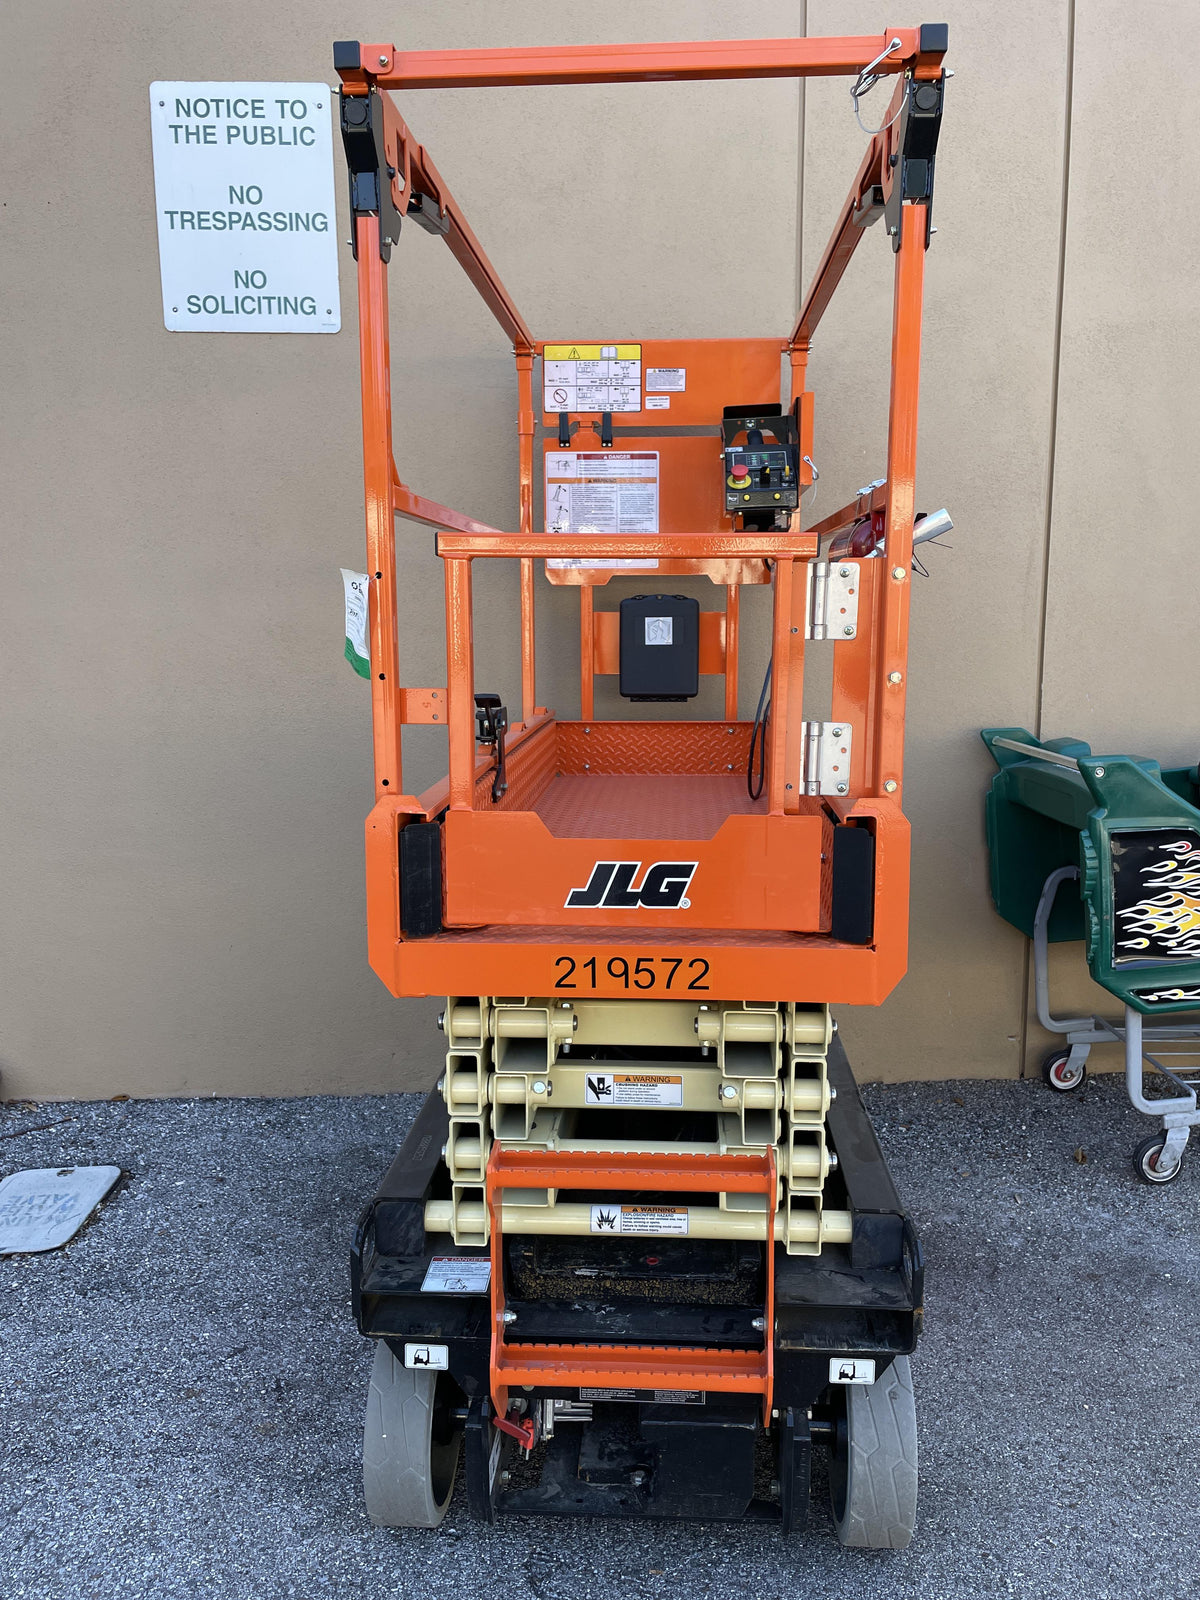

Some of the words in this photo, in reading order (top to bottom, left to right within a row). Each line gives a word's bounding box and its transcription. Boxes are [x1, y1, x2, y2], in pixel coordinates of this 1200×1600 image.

[175, 98, 265, 119] NOTICE
[275, 99, 307, 120] TO
[169, 125, 218, 145] THE
[227, 125, 316, 147] PUBLIC
[228, 185, 263, 205] NO
[164, 210, 329, 232] TRESPASSING
[233, 270, 267, 290] NO
[187, 295, 317, 316] SOLICITING
[564, 861, 700, 909] JLG
[554, 956, 710, 990] 219572
